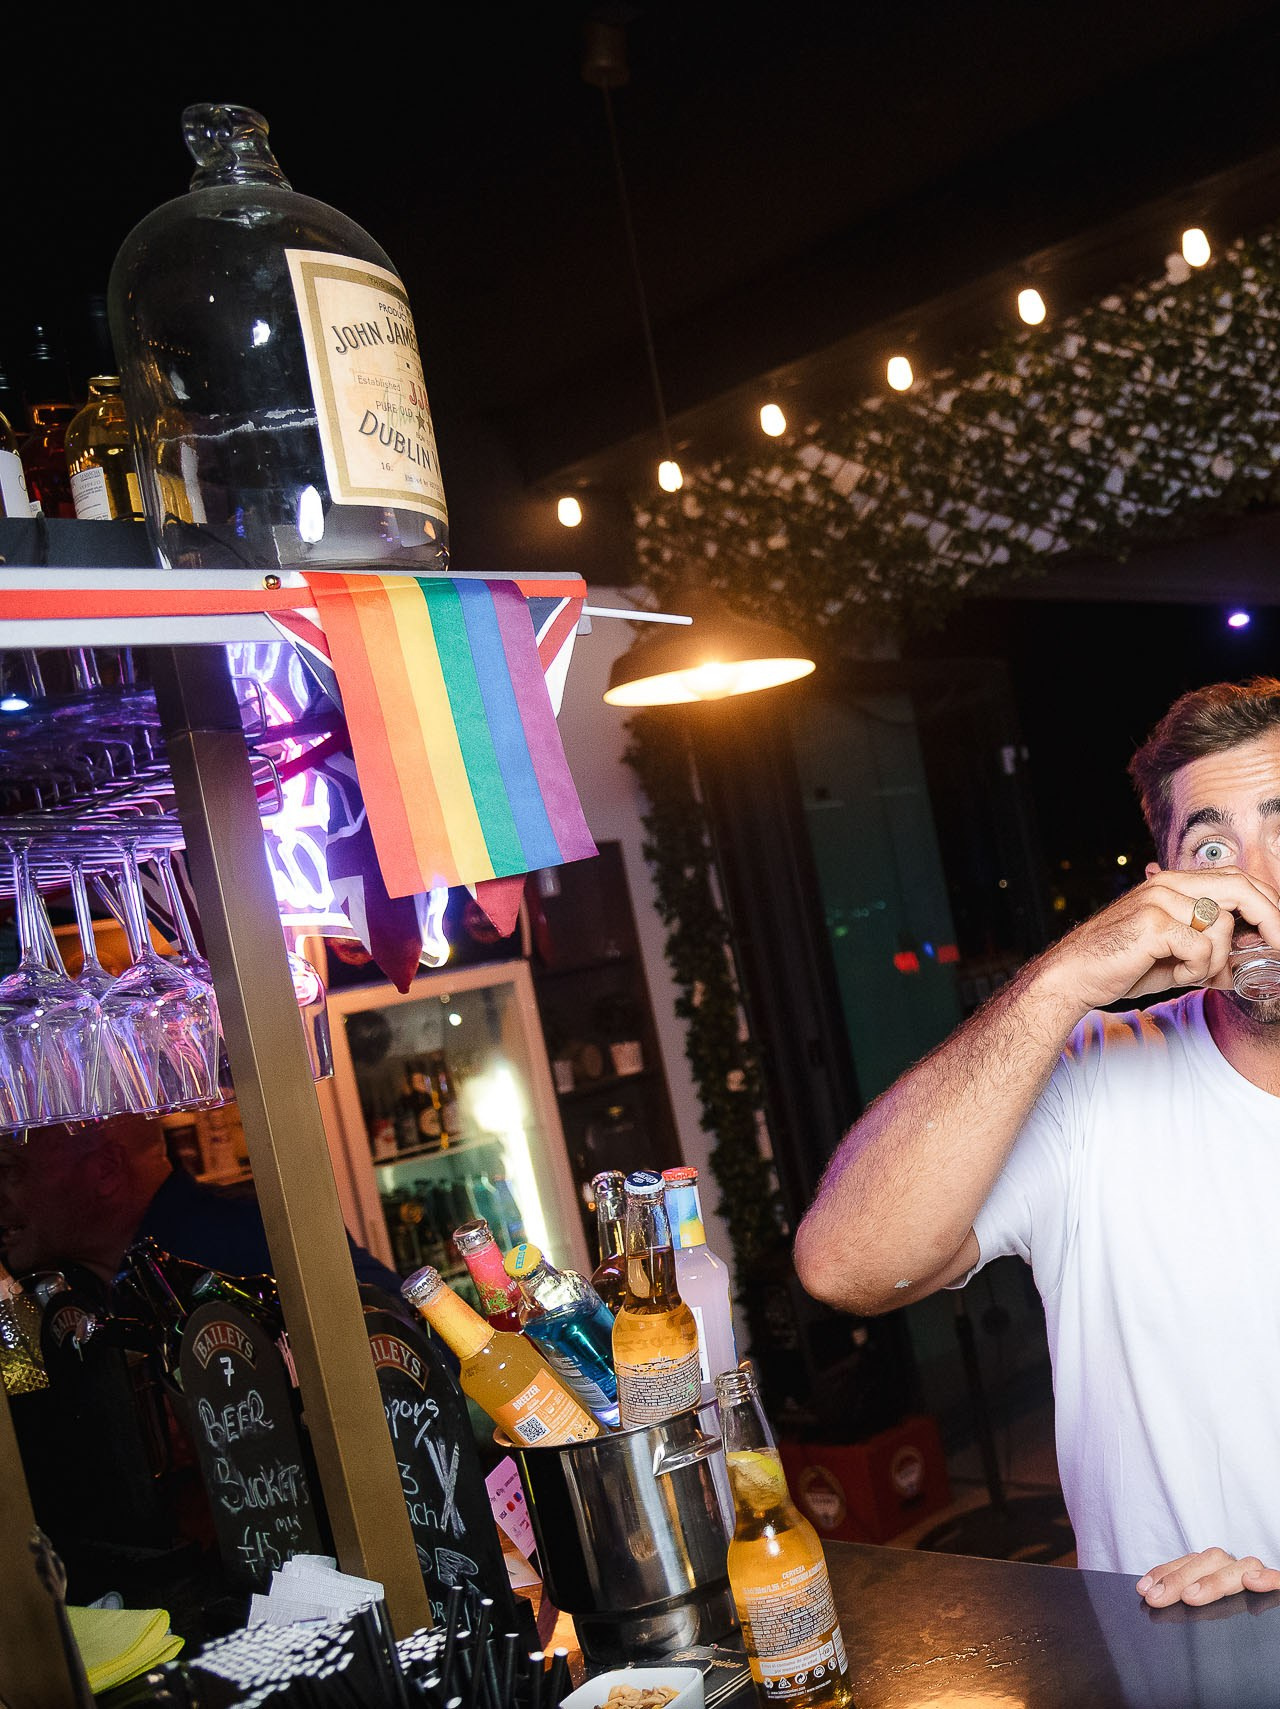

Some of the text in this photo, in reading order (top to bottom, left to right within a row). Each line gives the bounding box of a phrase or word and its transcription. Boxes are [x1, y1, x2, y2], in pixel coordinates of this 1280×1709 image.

[331, 320, 385, 354] JOHN
[375, 400, 398, 414] PURE
[359, 409, 432, 472] DUBLIN
[197, 1326, 254, 1360] BAILEYS
[219, 1357, 235, 1387] 7
[371, 1340, 422, 1379] ILEYS
[512, 1384, 541, 1411] BREEZER
[198, 1390, 274, 1448] BEER
[407, 1502, 439, 1530] ach
[782, 1565, 806, 1580] CERVEZA
